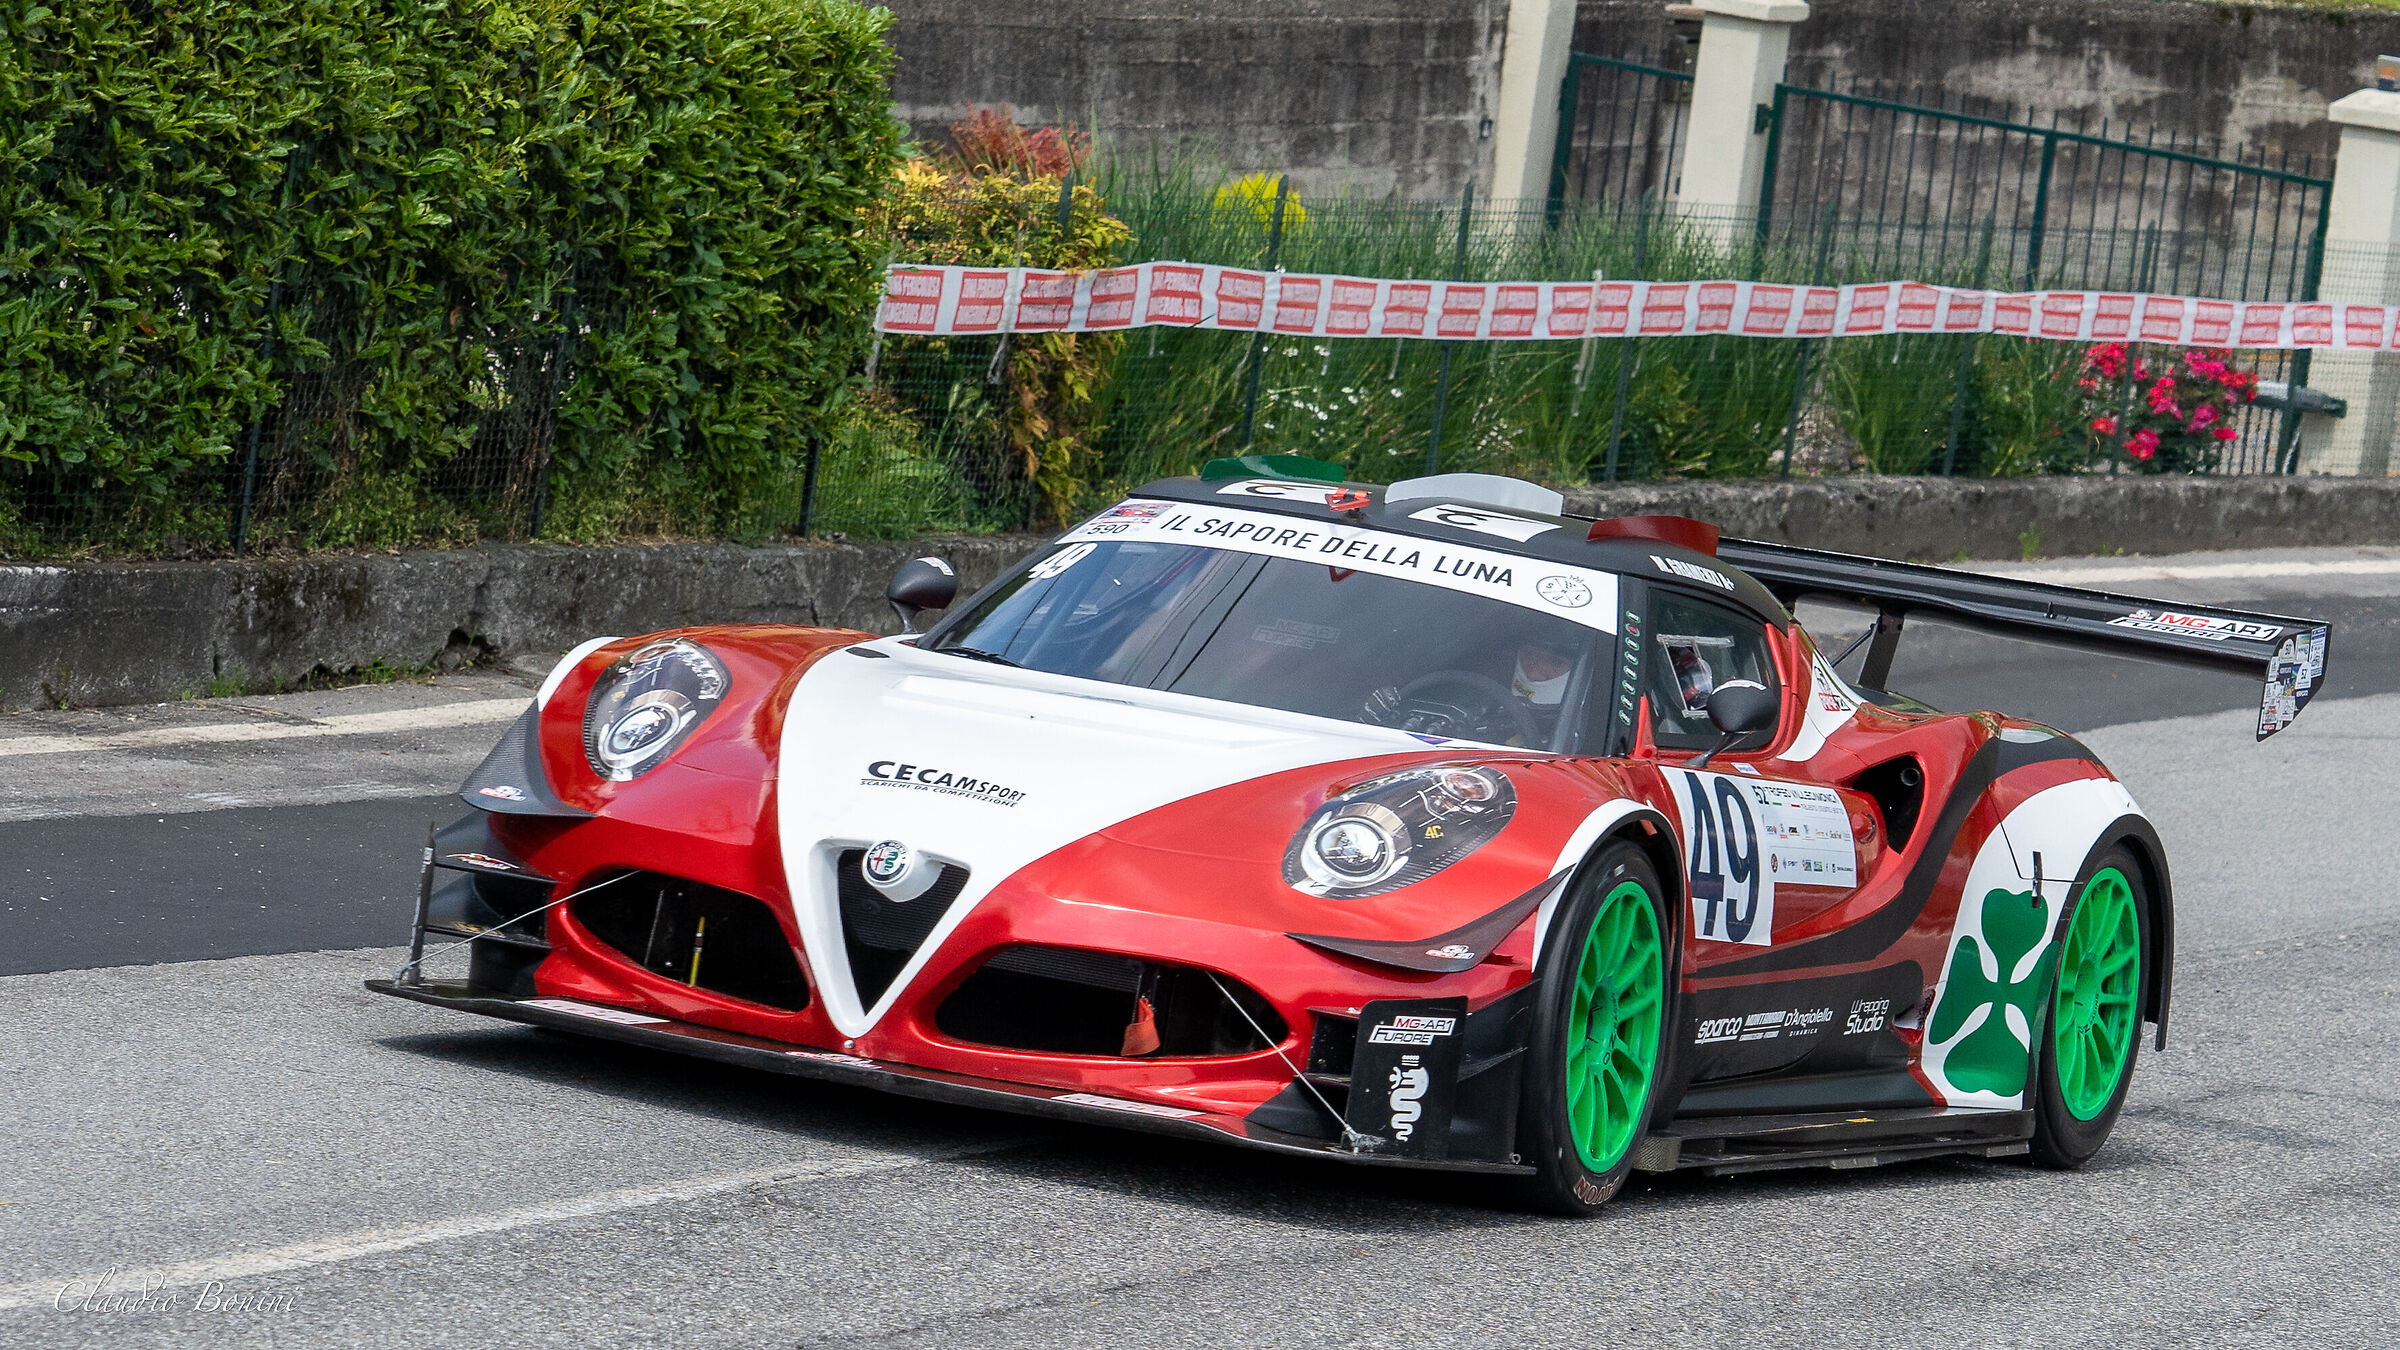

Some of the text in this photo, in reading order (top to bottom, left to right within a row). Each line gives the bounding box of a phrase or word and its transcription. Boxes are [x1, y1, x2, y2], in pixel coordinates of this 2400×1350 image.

[1087, 524, 1130, 535] 590
[1160, 514, 1512, 587] IL SAPORE DELLA LUNA
[2159, 613, 2279, 640] MG-AR1
[860, 779, 1018, 808] SCARICHI DA COMPETIZIONE
[867, 760, 1027, 803] CECAMSPORT
[1425, 824, 1444, 840] 4C
[1684, 770, 1761, 944] 49
[1395, 1018, 1453, 1031] MG-AR1
[1698, 1016, 1743, 1043] sparco
[1843, 1012, 1884, 1036] Studio
